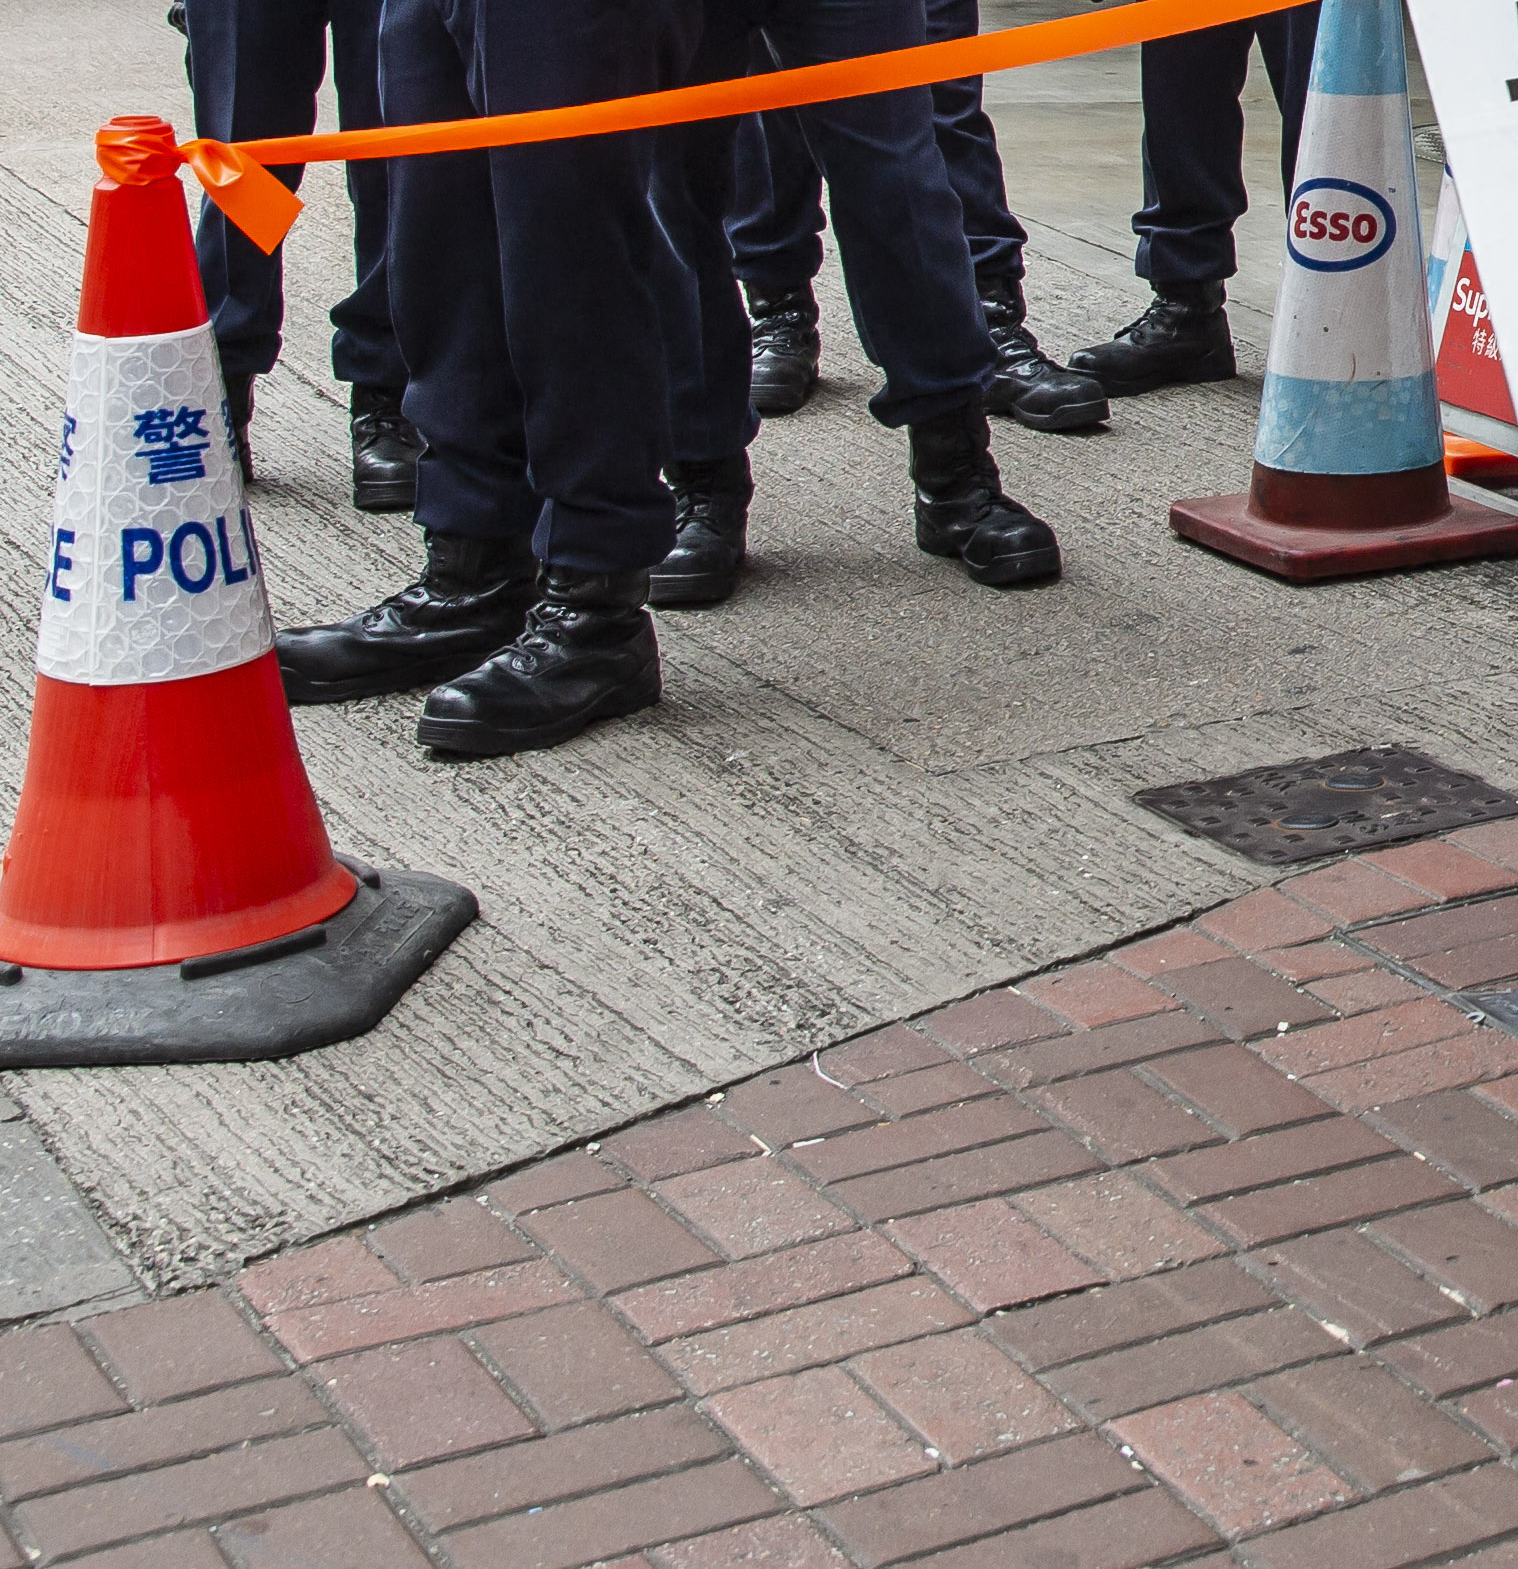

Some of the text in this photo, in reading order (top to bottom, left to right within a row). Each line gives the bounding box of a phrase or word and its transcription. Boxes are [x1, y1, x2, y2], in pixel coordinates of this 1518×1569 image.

[1294, 200, 1378, 243] Esso
[1452, 277, 1491, 328] Sup
[133, 405, 211, 485] 警
